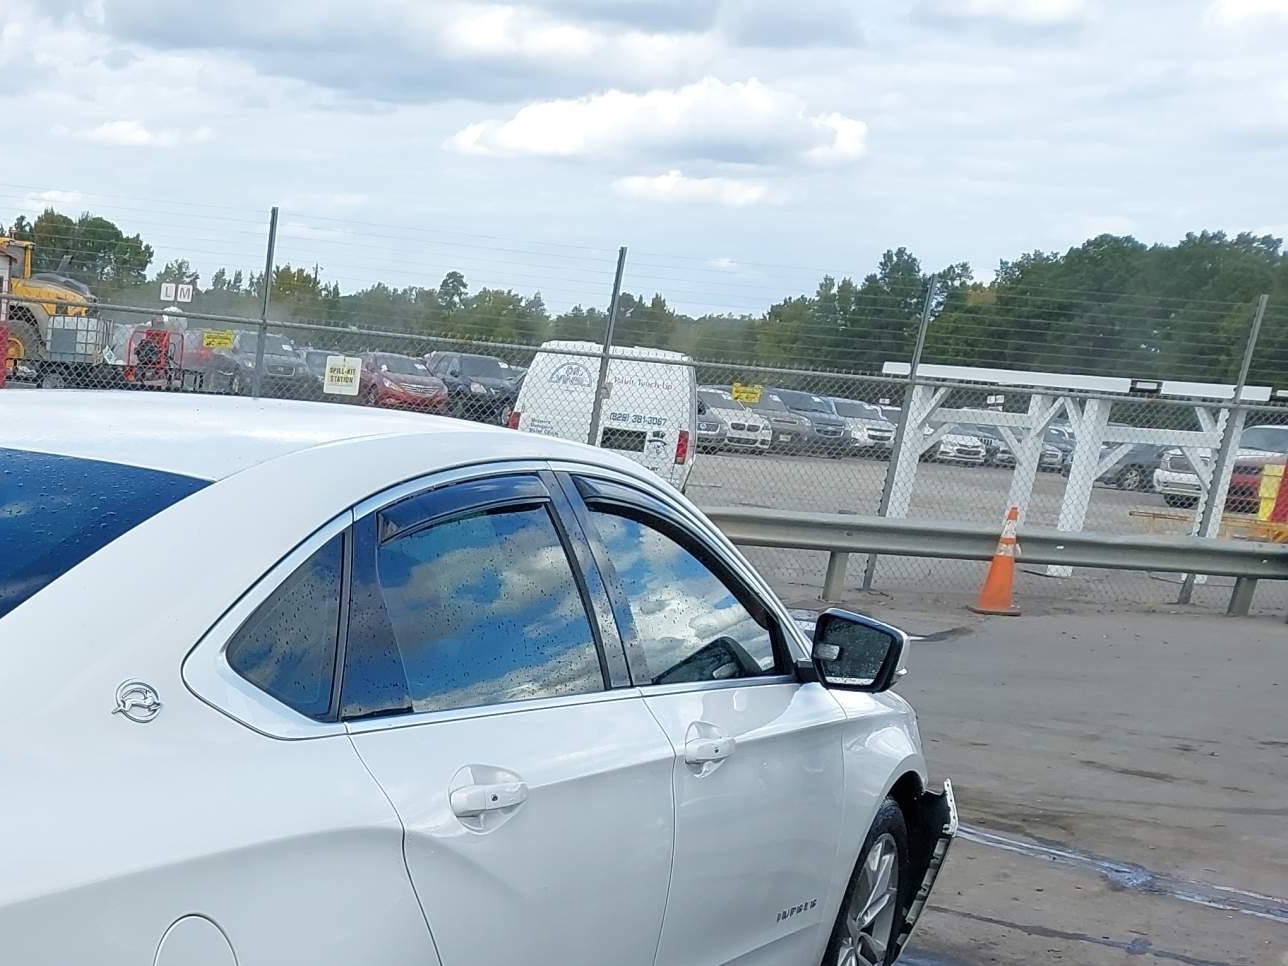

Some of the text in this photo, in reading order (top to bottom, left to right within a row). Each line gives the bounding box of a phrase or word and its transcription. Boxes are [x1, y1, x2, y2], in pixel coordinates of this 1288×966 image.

[164, 286, 171, 299] L
[179, 287, 190, 300] M
[330, 375, 354, 383] STATION
